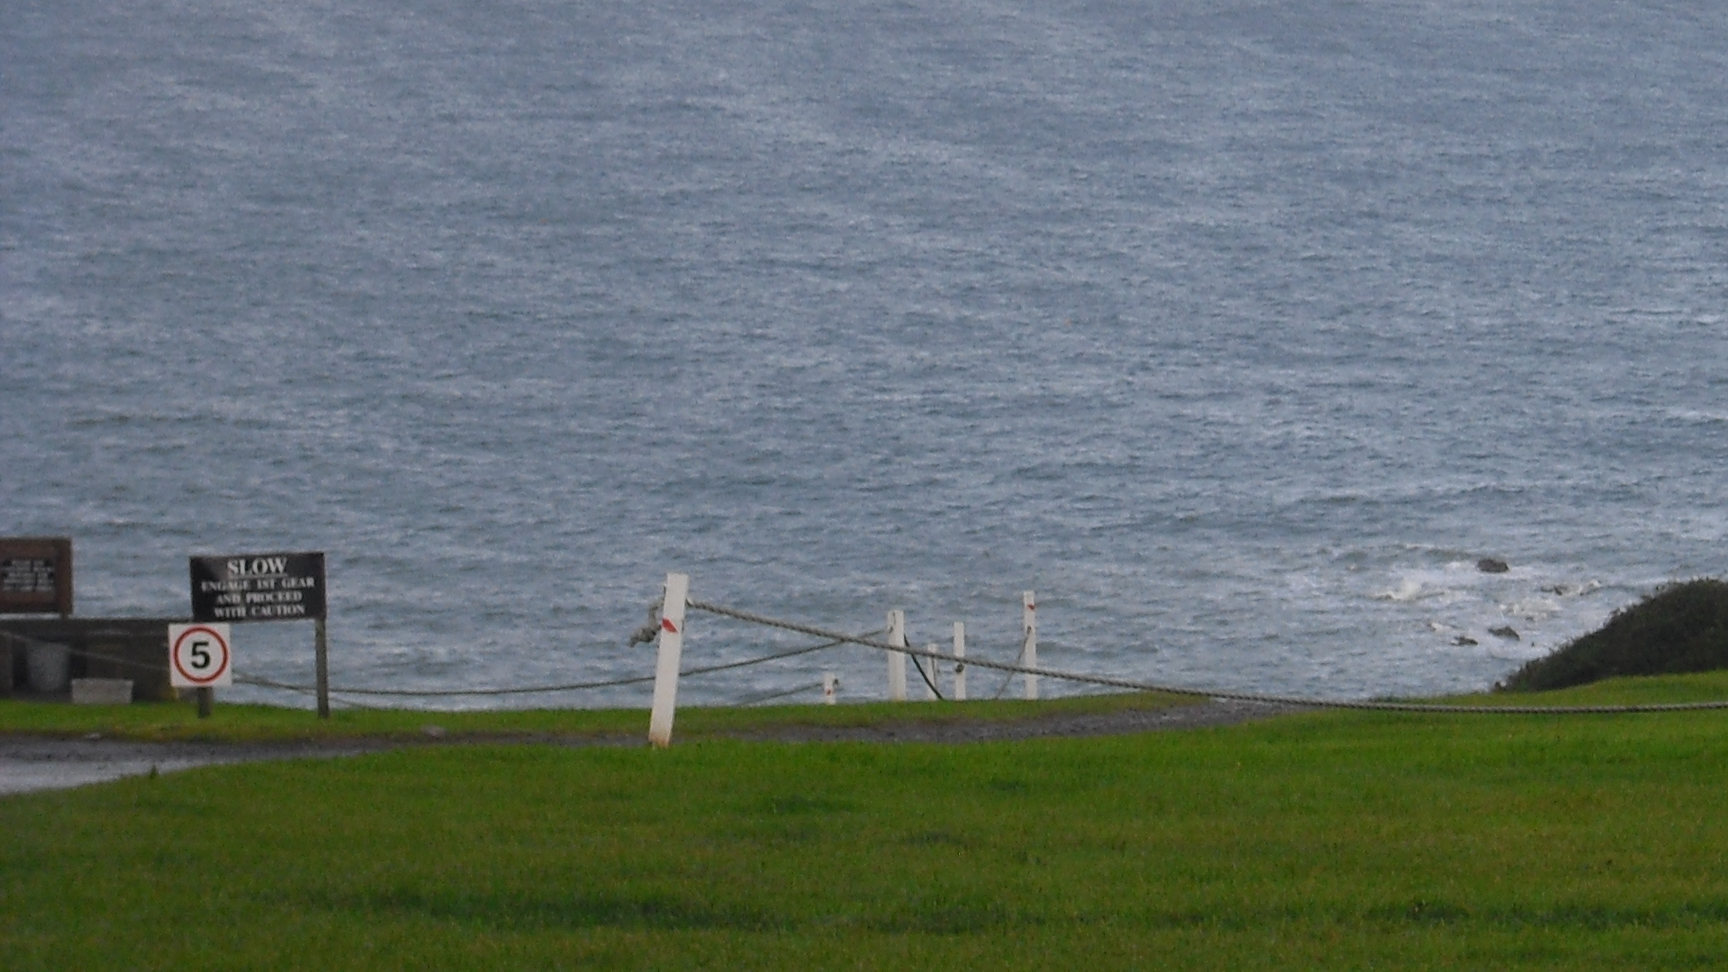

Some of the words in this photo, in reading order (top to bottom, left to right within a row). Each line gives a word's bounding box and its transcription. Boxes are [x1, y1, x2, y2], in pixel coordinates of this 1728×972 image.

[227, 557, 287, 574] SLOW
[201, 580, 249, 591] ENGAGE
[281, 576, 315, 588] GEAR
[217, 593, 241, 604] AND
[246, 591, 303, 603] PROCEED
[214, 606, 246, 617] WITH
[251, 604, 305, 616] CAUTION
[191, 641, 211, 668] 5
